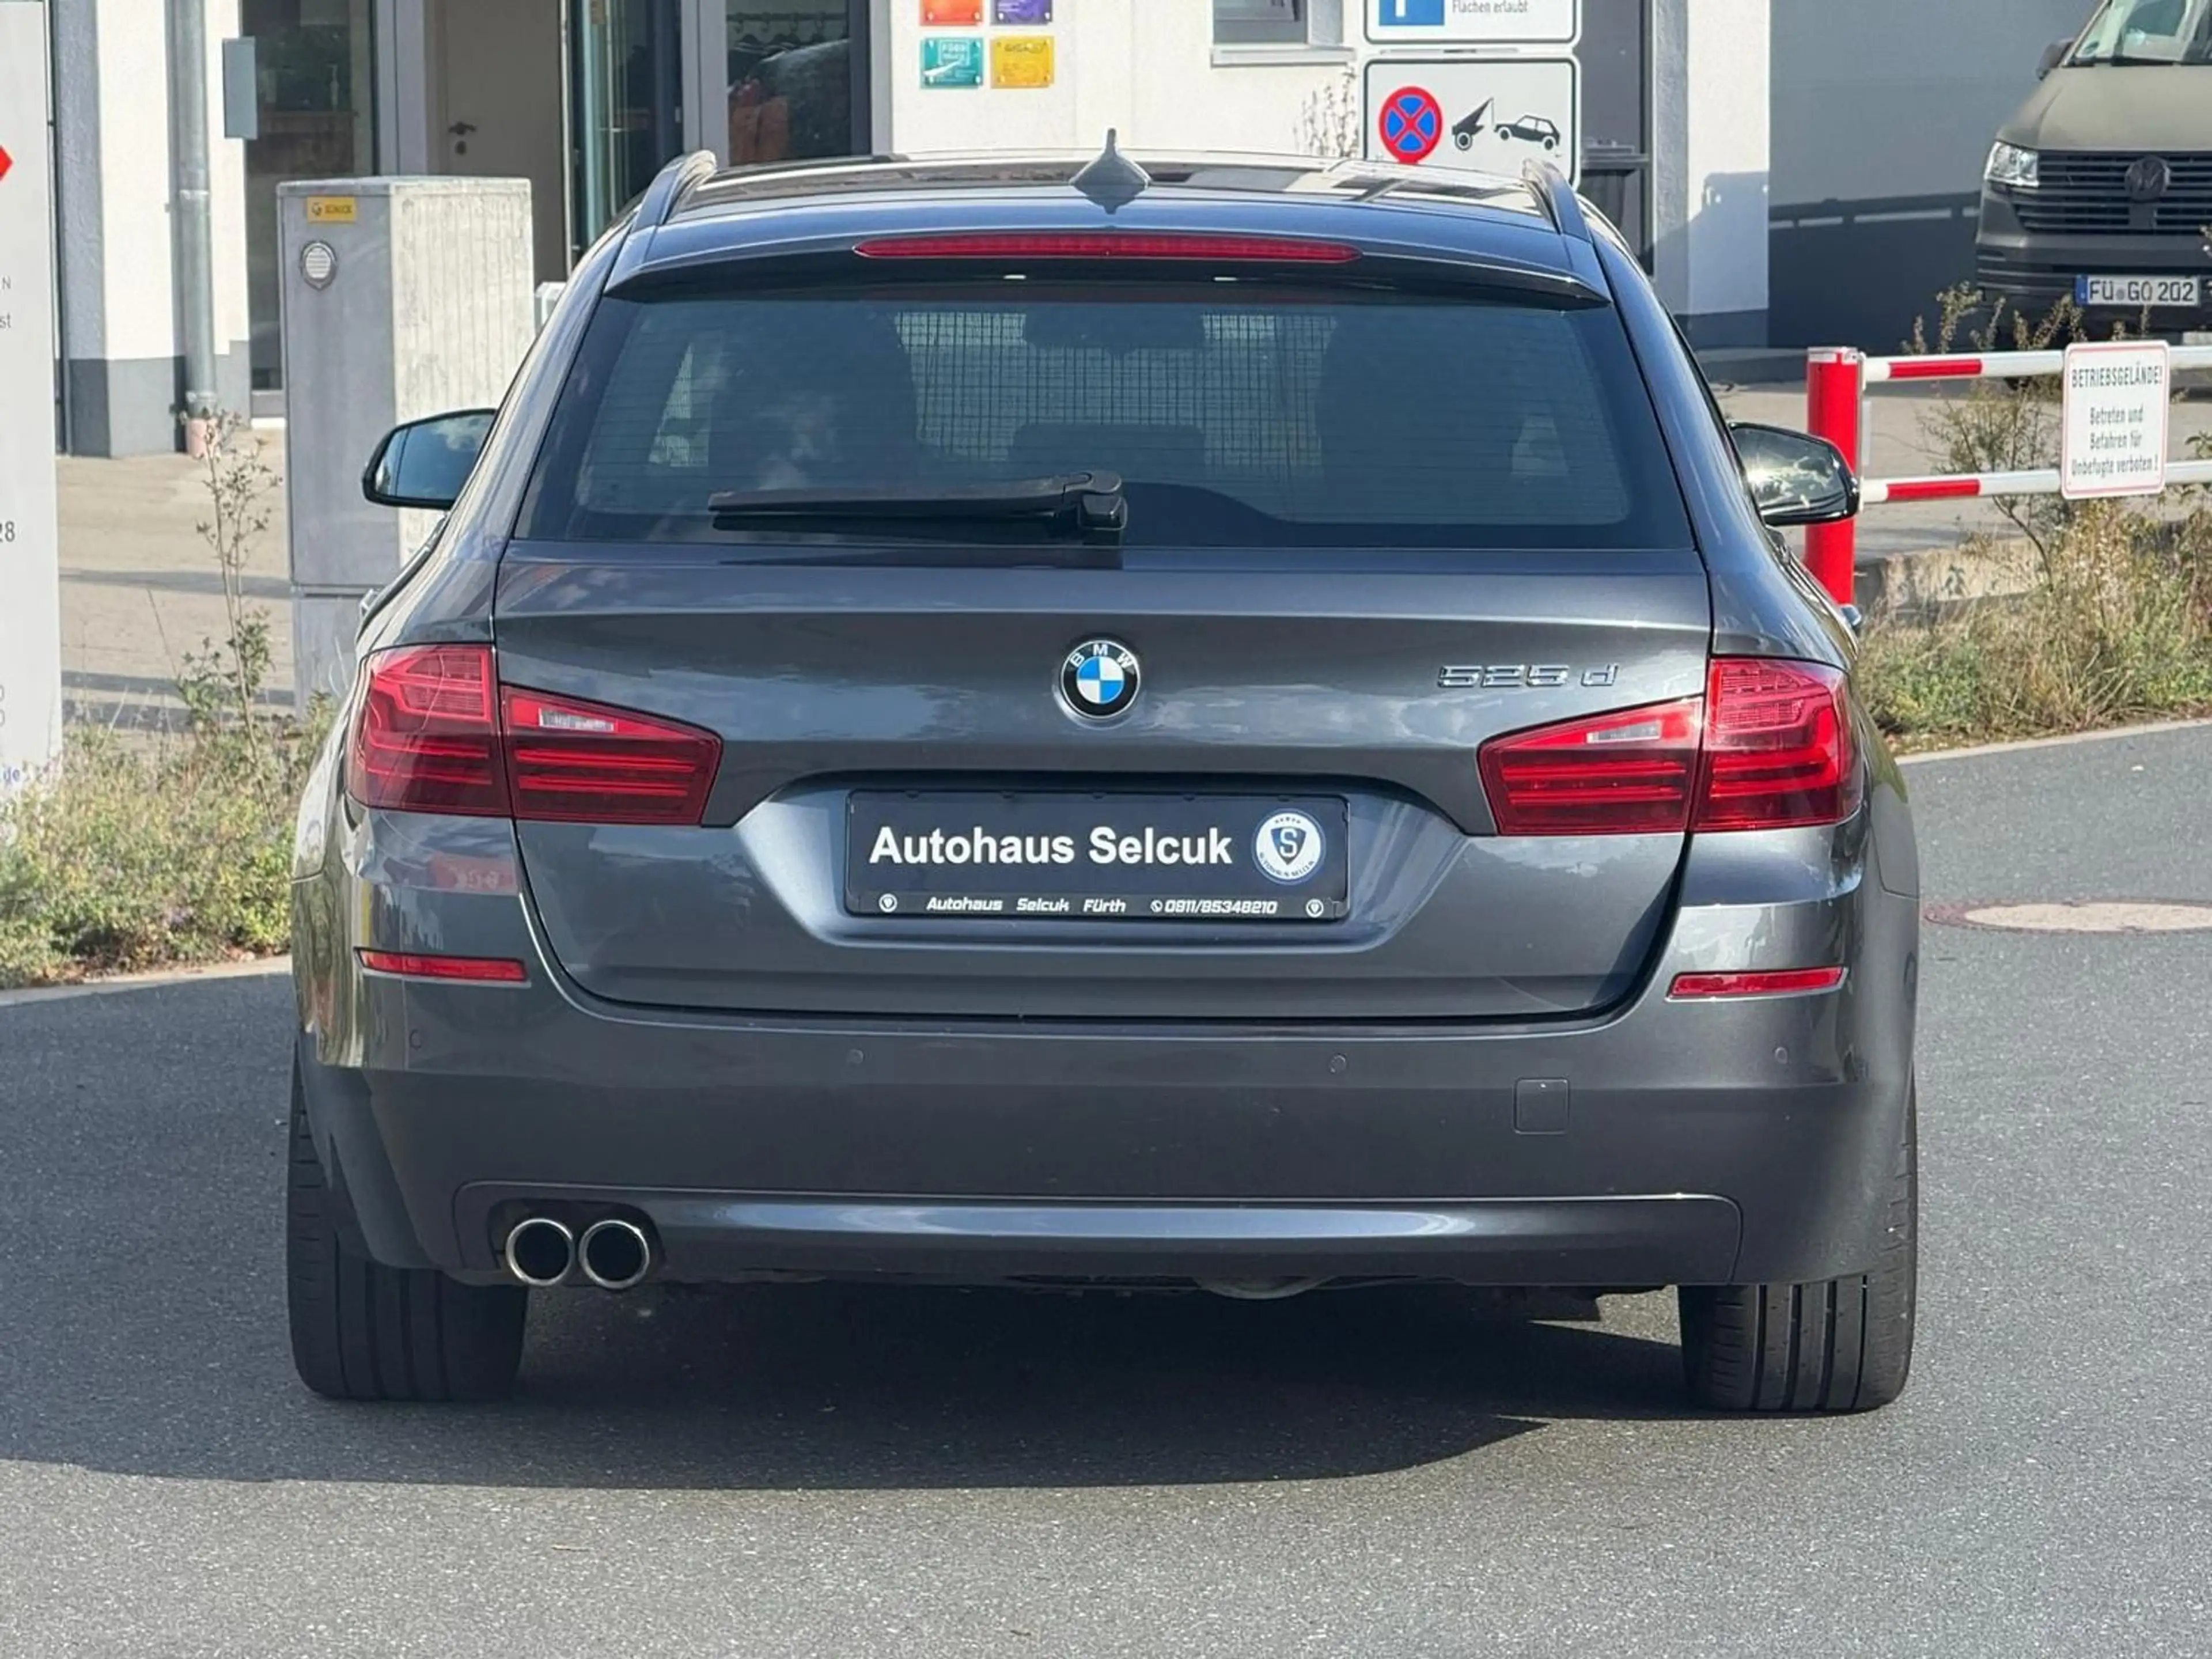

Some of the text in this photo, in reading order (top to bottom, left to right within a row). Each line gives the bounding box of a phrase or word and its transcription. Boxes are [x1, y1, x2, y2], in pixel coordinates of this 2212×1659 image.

[2089, 280, 2194, 302] FÜ GO 202
[2072, 362, 2163, 388] BETRIEBSGELÄNDE!
[2090, 403, 2144, 425] Betreten und
[2090, 433, 2127, 450] Befahren
[2071, 458, 2114, 478] Unbefugte
[1070, 643, 1135, 668] BMW
[1437, 663, 1618, 688] 525 d
[869, 825, 1075, 864] Autohaus
[1089, 826, 1232, 864] Selcuk
[926, 896, 1003, 911] Autohaus
[1016, 897, 1070, 912] Selcuk
[1083, 898, 1127, 912] Fürth
